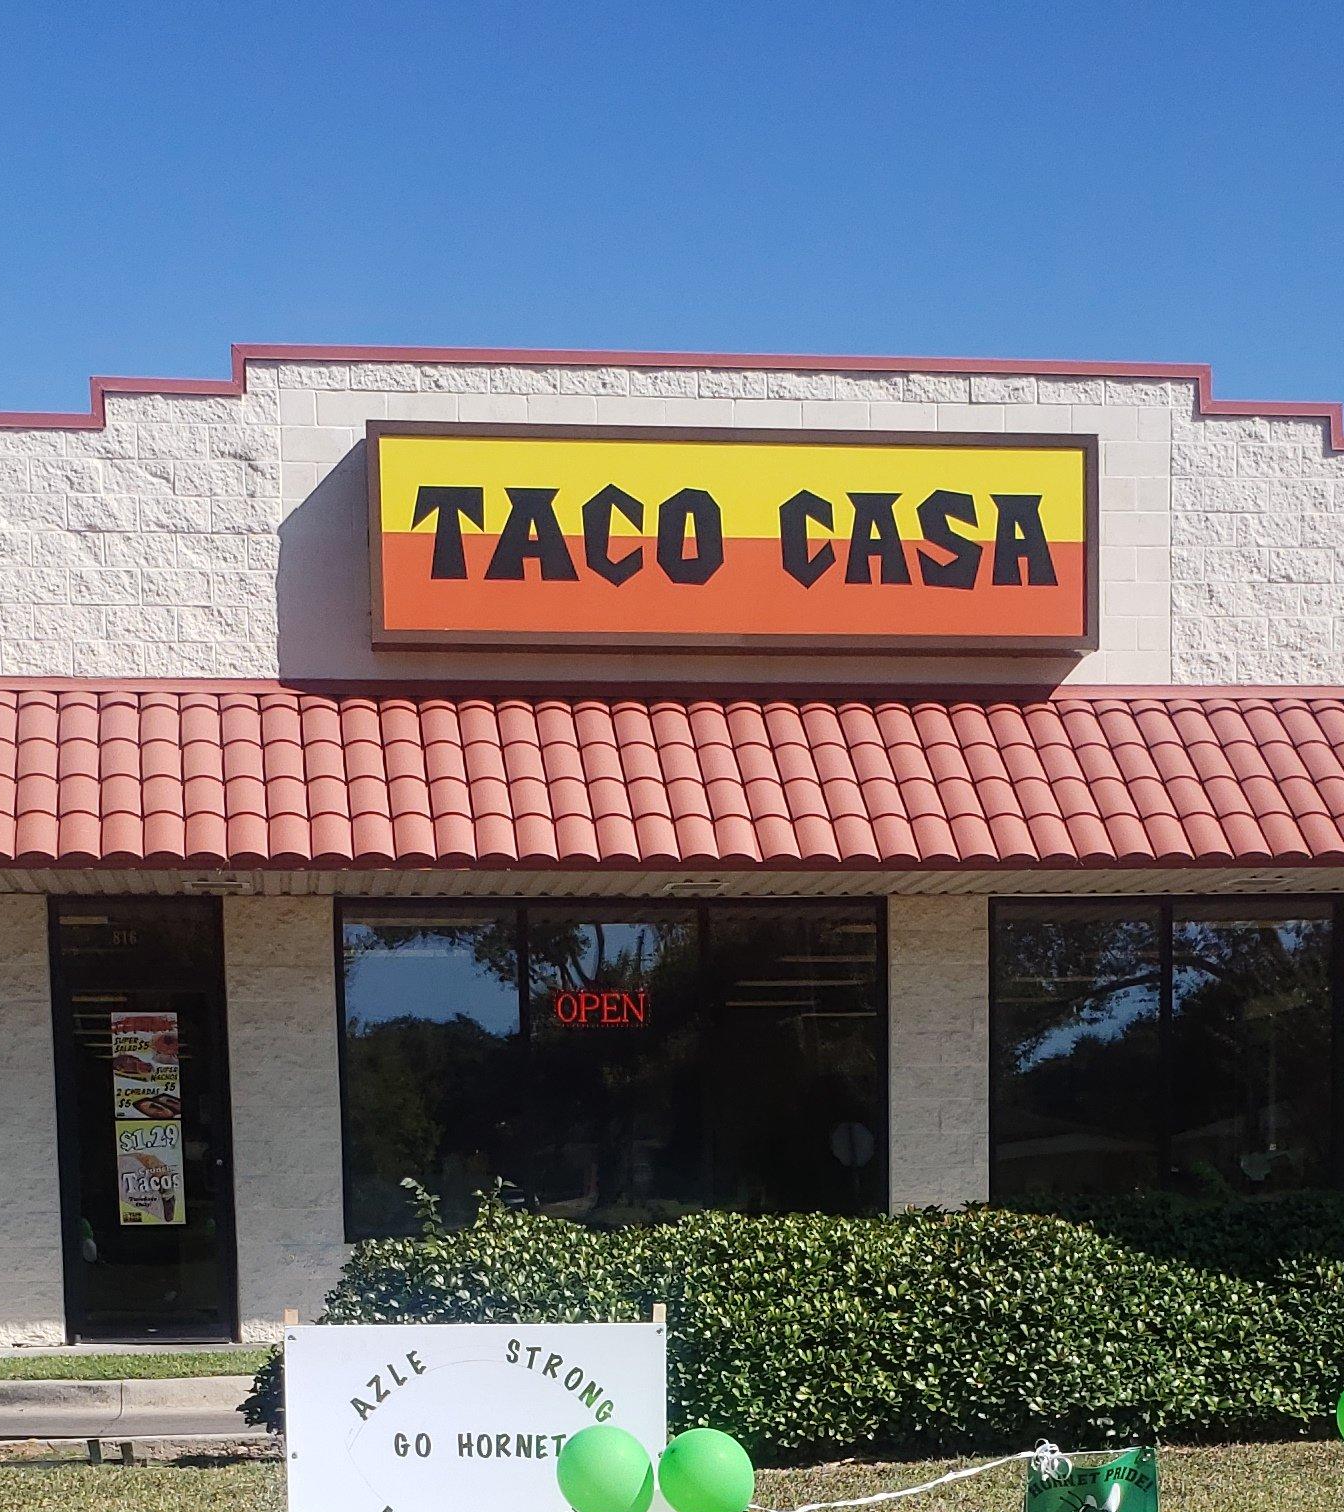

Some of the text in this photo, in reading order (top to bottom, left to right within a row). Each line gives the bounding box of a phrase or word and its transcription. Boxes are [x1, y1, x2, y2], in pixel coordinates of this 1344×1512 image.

[411, 483, 1058, 590] TACO CASA
[557, 990, 646, 1023] OPEN
[119, 1124, 180, 1152] $1.29
[121, 1172, 184, 1194] Tacos
[350, 1338, 614, 1423] AZLE STRONG
[394, 1432, 567, 1460] GO HORNET
[1104, 1466, 1155, 1493] PRIDE!
